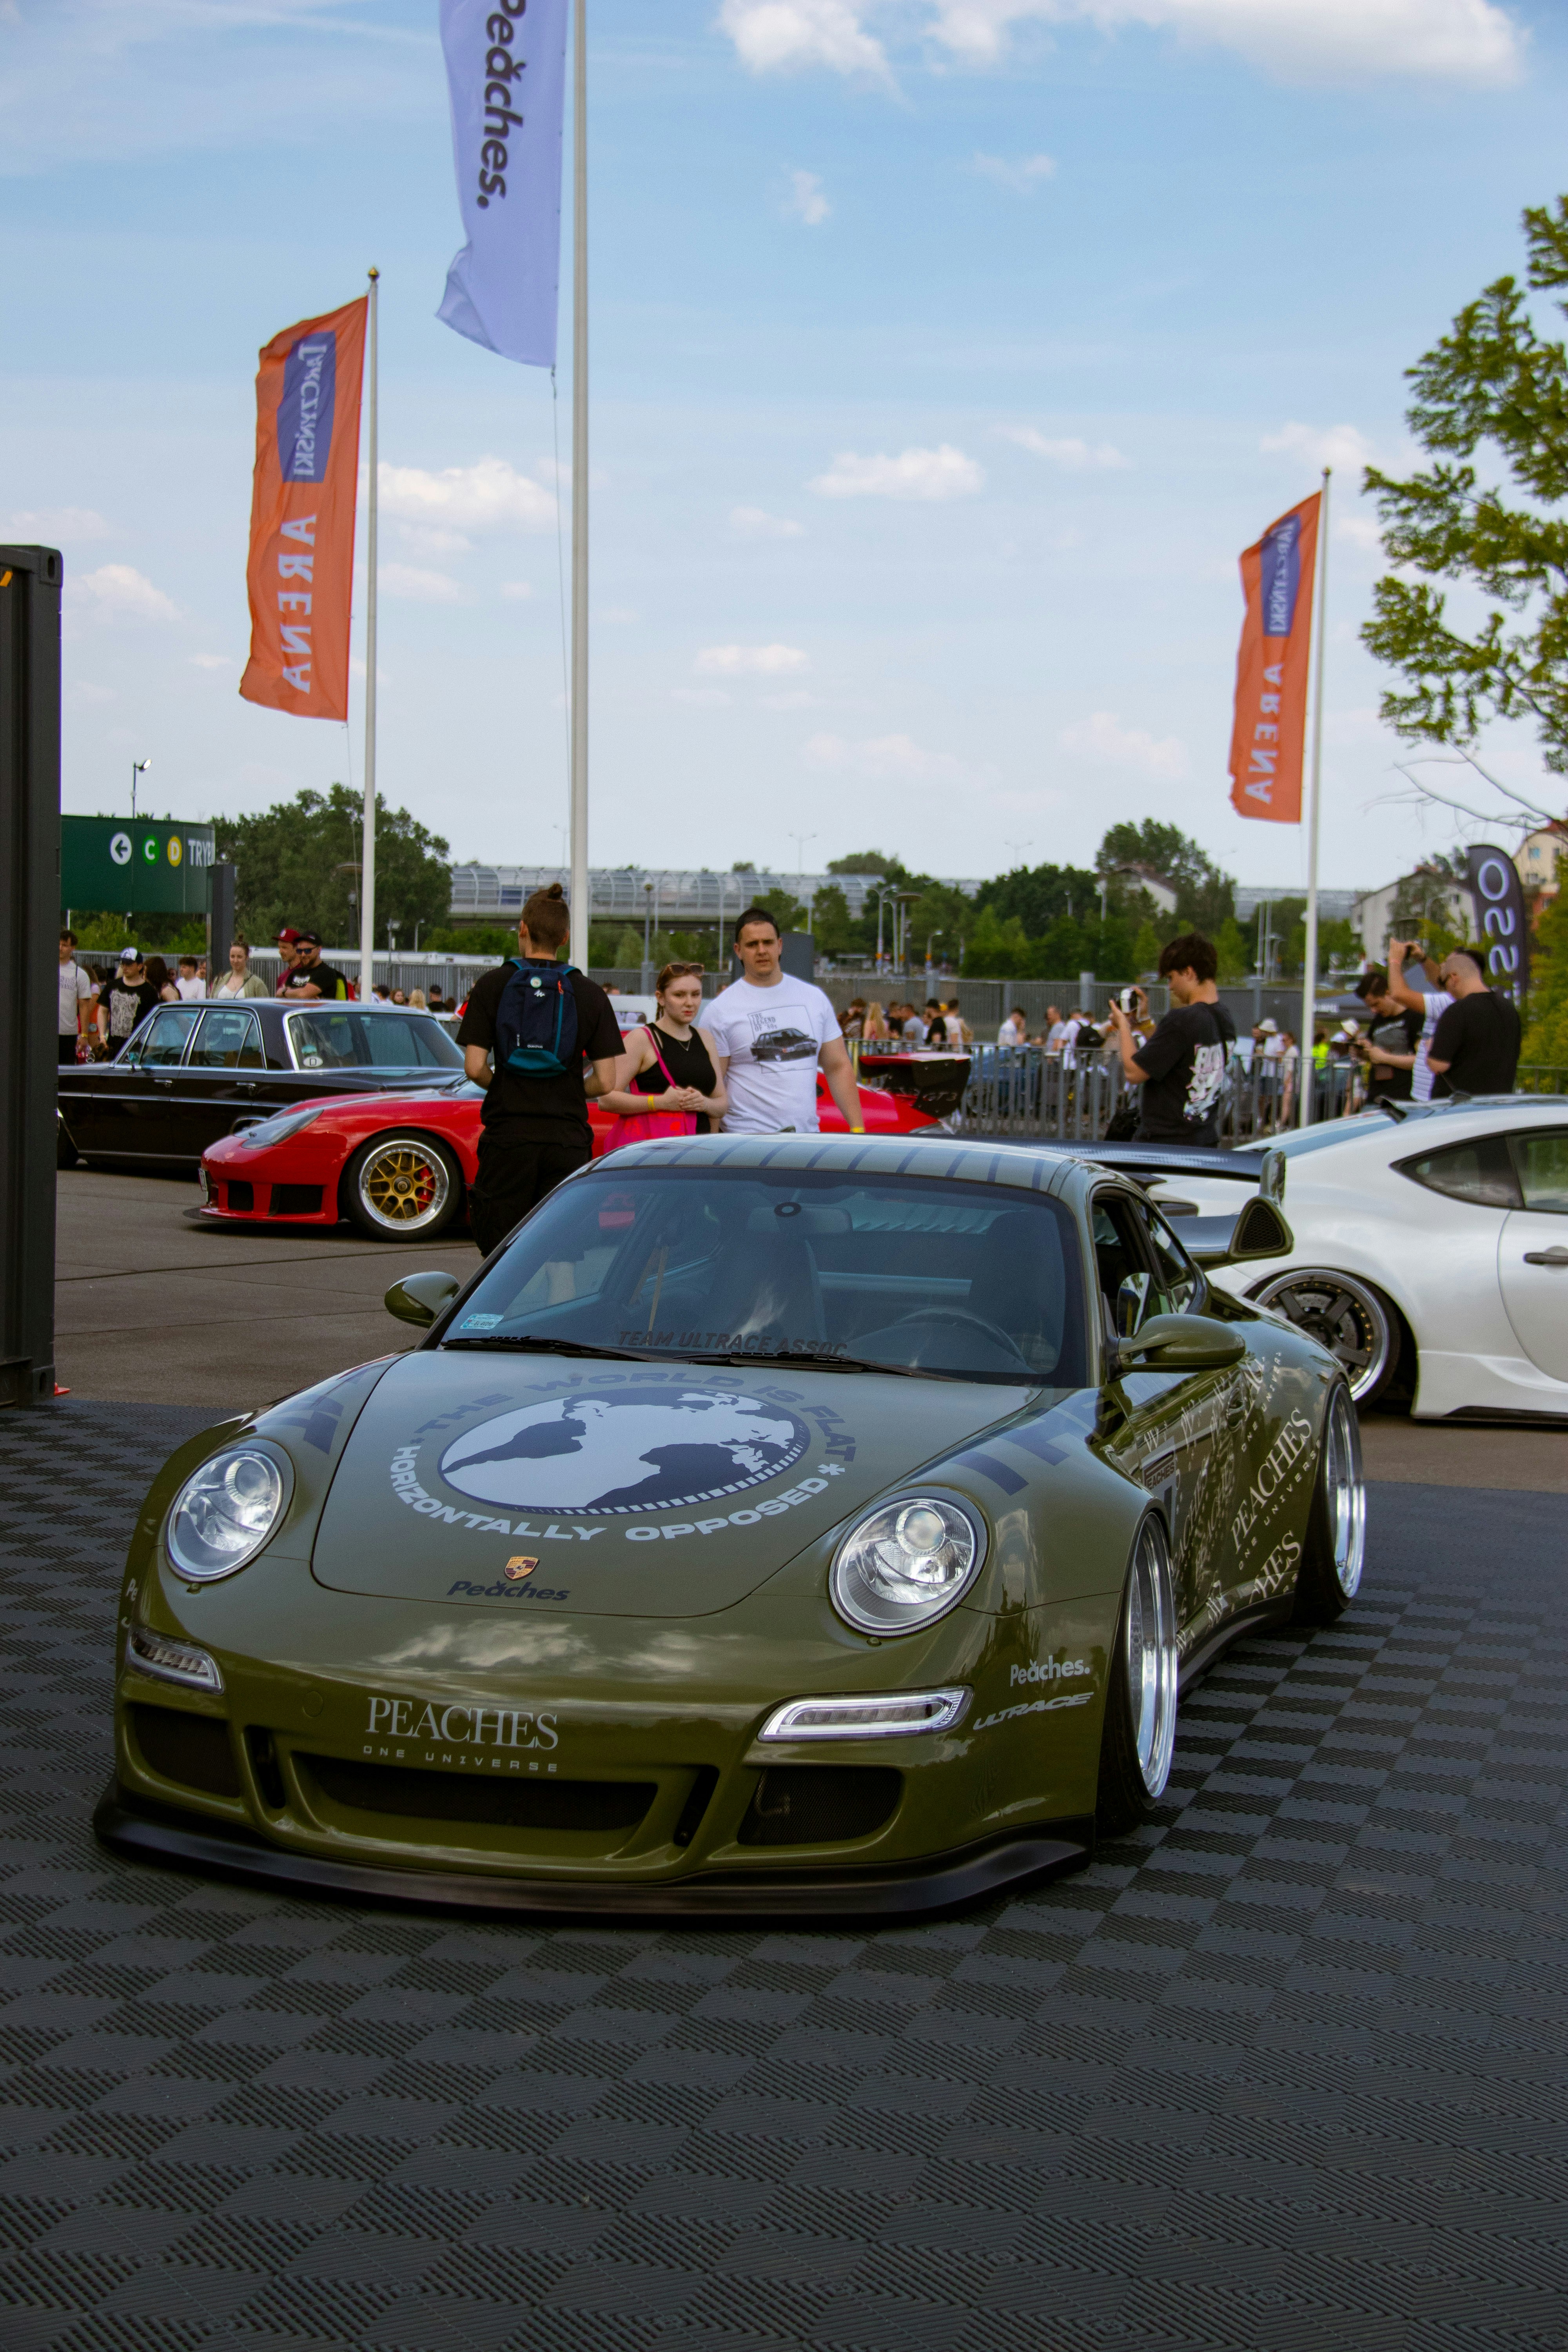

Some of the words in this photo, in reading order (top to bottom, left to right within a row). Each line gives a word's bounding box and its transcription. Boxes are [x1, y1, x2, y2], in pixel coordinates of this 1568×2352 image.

[145, 839, 155, 860] C
[171, 842, 179, 861] D
[310, 1058, 317, 1066] D
[617, 1331, 675, 1347] TEAM
[678, 1332, 772, 1352] ULTRACE
[414, 1394, 514, 1434] THE
[523, 1372, 744, 1391] WORLD
[752, 1386, 805, 1403] IS
[799, 1405, 856, 1462] FLAT
[390, 1445, 609, 1541] HORIZONTALLY
[625, 1478, 829, 1541] OPPOSED
[1231, 1407, 1312, 1555] PEACHES
[365, 1697, 559, 1750] PEACHES
[973, 1691, 1094, 1730] ULTRACE
[363, 1745, 405, 1758] ONE
[426, 1752, 557, 1773] UNIVERSE
